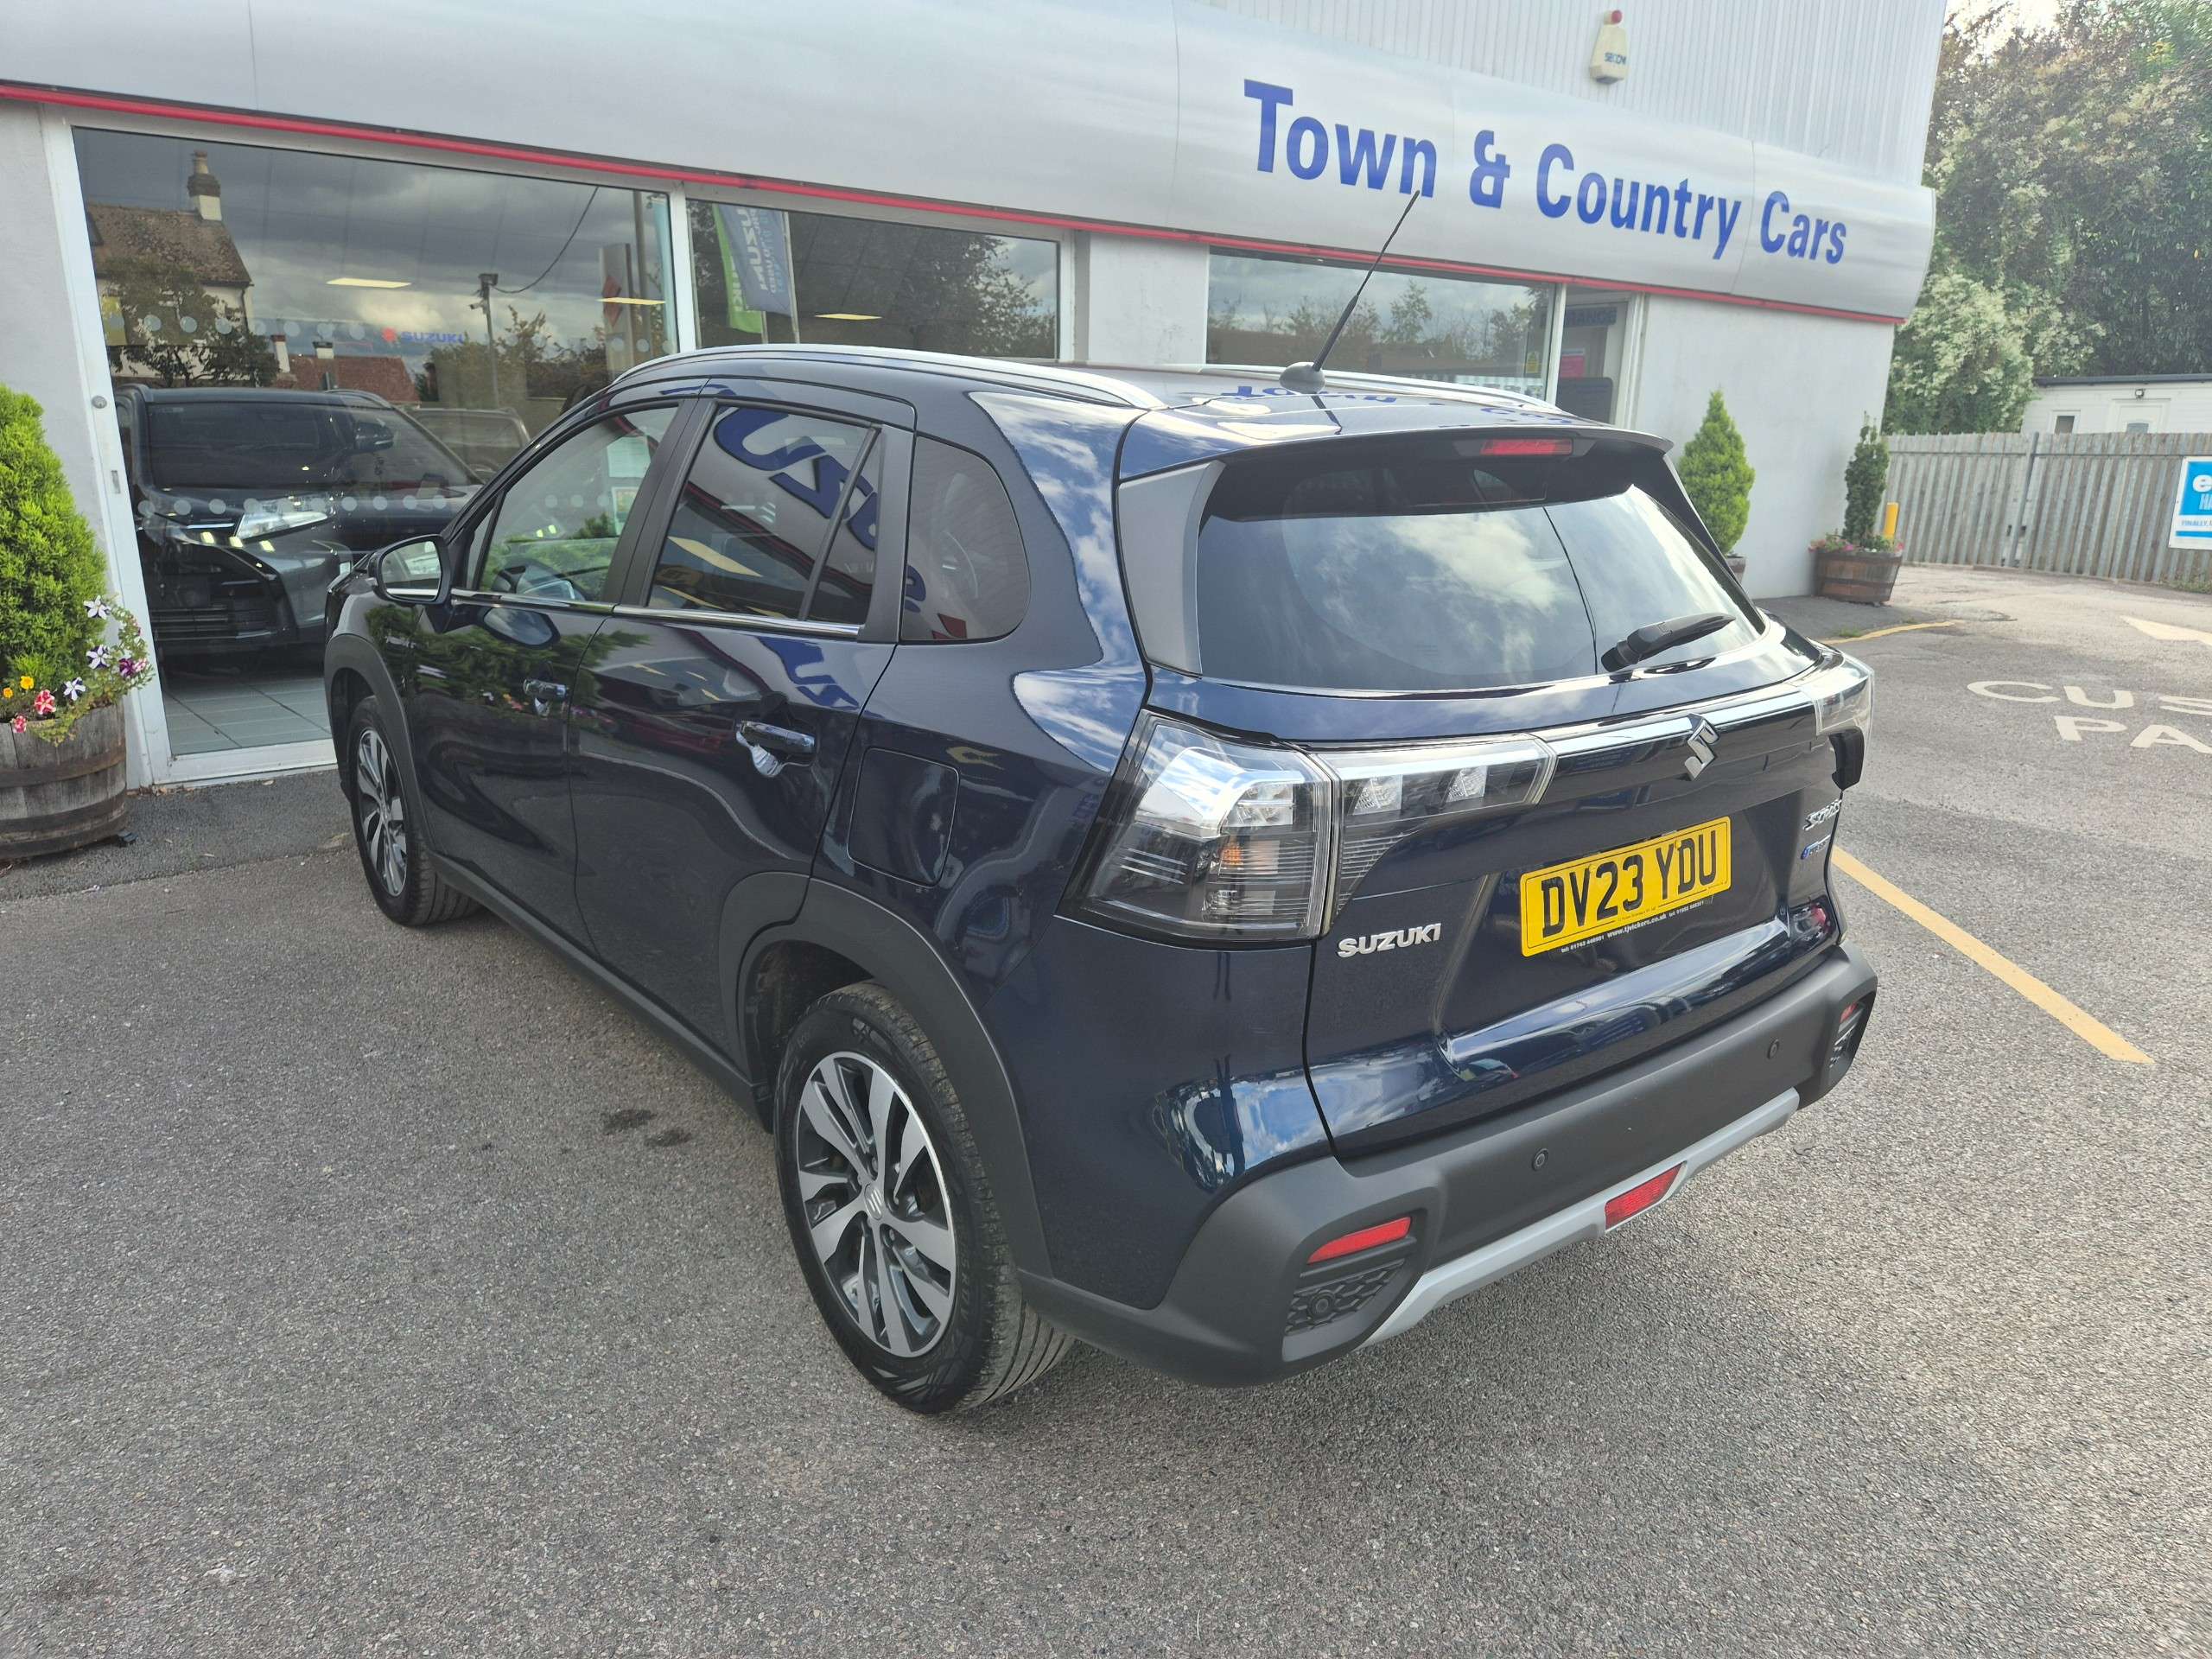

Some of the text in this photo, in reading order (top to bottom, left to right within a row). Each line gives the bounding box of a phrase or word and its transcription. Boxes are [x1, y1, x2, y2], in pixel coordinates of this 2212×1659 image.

[1244, 79, 1847, 264] Town & Country Cars
[401, 331, 464, 344] SUZUKI
[2054, 715, 2212, 754] PA
[1541, 830, 1717, 938] DV23 YDU
[1338, 923, 1442, 958] SUZUKI
